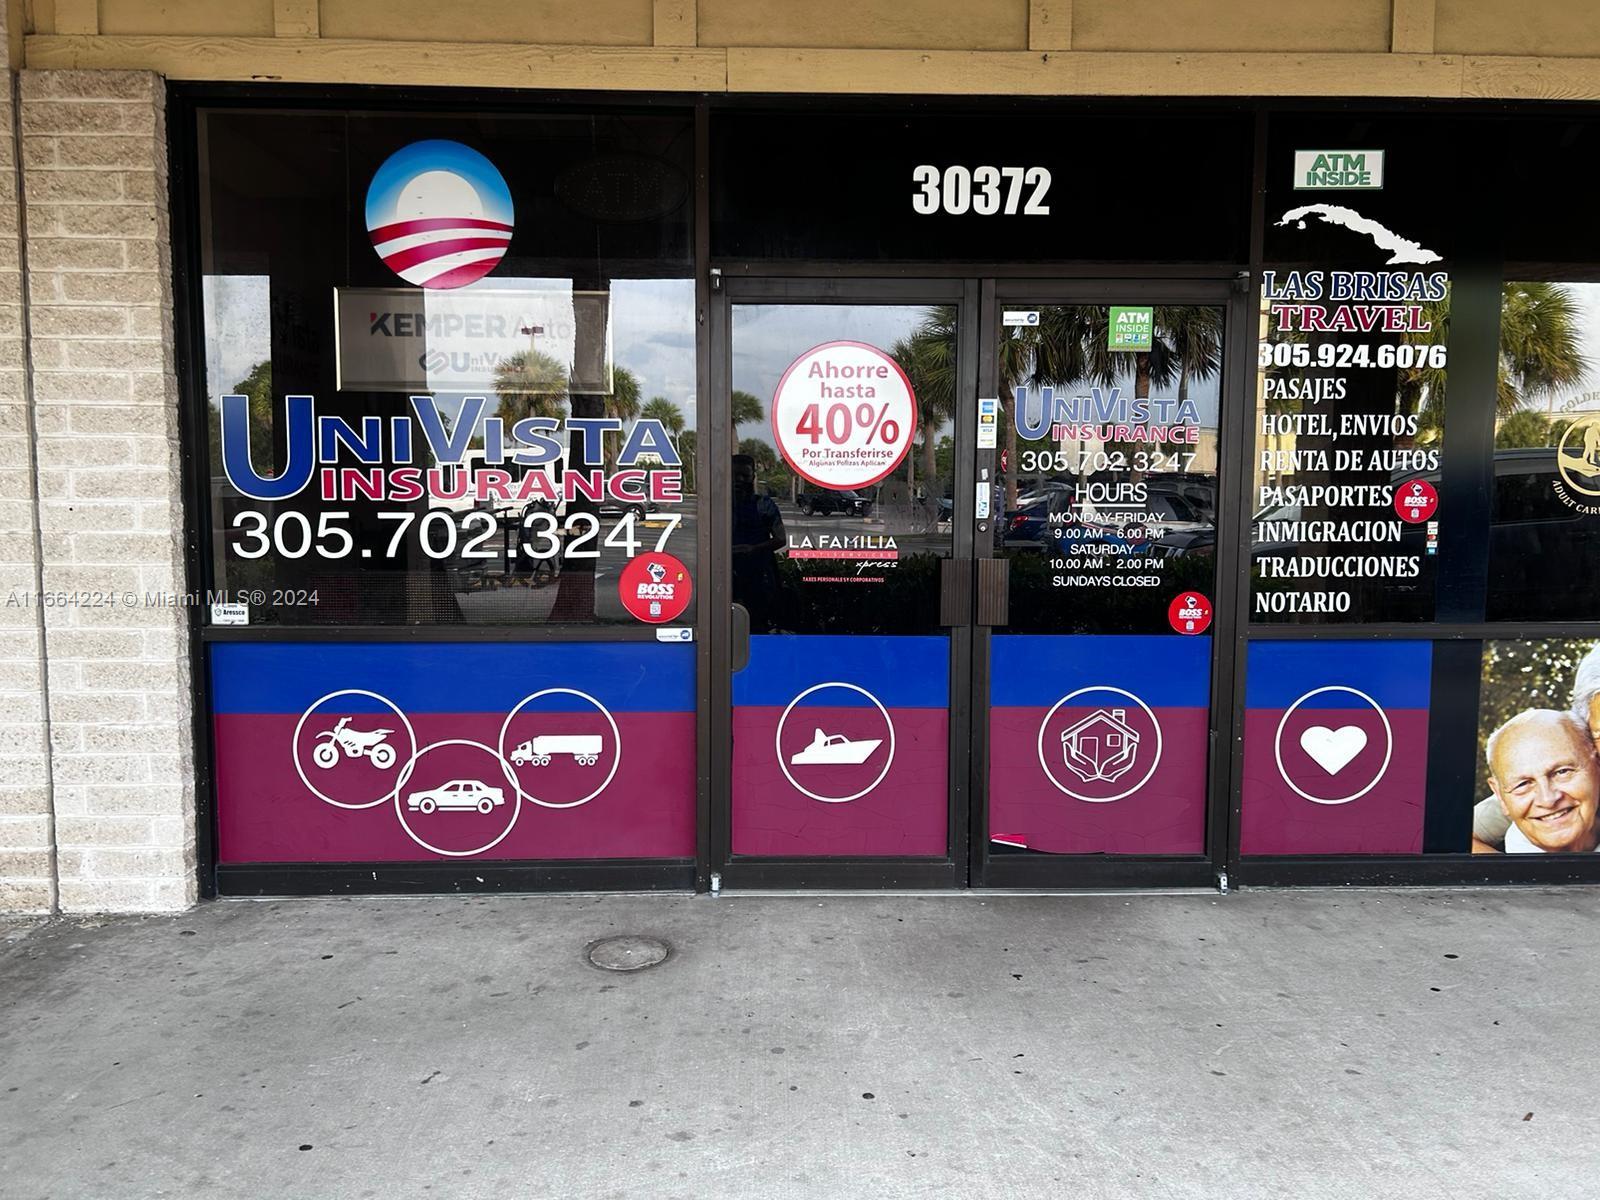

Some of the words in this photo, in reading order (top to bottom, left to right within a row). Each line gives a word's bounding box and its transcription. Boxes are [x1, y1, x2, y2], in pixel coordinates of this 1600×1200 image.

[1311, 154, 1366, 172] ATM
[1306, 172, 1371, 186] INSIDE
[912, 165, 1052, 216] 30372
[1262, 271, 1324, 301] LAS
[1330, 271, 1448, 302] BRISAS
[370, 312, 507, 338] KEMPER
[1116, 324, 1149, 333] INSIDE
[1117, 312, 1150, 324] ATM
[1272, 305, 1432, 333] TRAVEL
[1257, 343, 1447, 369] 305.924.6076
[808, 360, 889, 379] Ahorre
[820, 382, 876, 398] hasta
[1262, 377, 1347, 405] PASAJES
[795, 402, 900, 445] 40%
[1051, 424, 1200, 445] INSURANCE
[802, 448, 823, 459] Por
[824, 448, 894, 459] Transferirse
[1021, 450, 1198, 472] 305.702.3247
[1259, 450, 1329, 472] RENTA
[1334, 450, 1365, 472] DE
[1368, 450, 1439, 472] AUTOS
[320, 468, 684, 503] INSURANCE
[1075, 482, 1148, 503] HOURS
[1258, 485, 1394, 507] PASAPORTES
[1552, 479, 1577, 509] ADULT
[1049, 512, 1166, 524] MONDAY-FRIDAY
[231, 511, 682, 560] 305.702.3247
[789, 535, 813, 548] LA
[819, 535, 898, 549] FAMILIA
[1055, 528, 1083, 540] 9.00
[1084, 528, 1104, 540] AM
[1116, 528, 1143, 540] 6.00
[1145, 528, 1165, 540] PM
[1257, 520, 1403, 543] INMIGRACION
[1070, 543, 1135, 555] SATURDAY
[855, 560, 899, 576] xpress
[1049, 558, 1083, 570] 10.00
[1084, 558, 1104, 570] AM
[1116, 558, 1143, 570] 2.00
[1145, 558, 1165, 570] PM
[1256, 555, 1420, 578] TRADUCCIONES
[637, 583, 675, 595] BOSS
[1052, 576, 1111, 587] SUNDAYS
[1113, 576, 1161, 588] CLOSED
[1178, 608, 1203, 616] BOSS
[1256, 591, 1351, 614] NOTARIO
